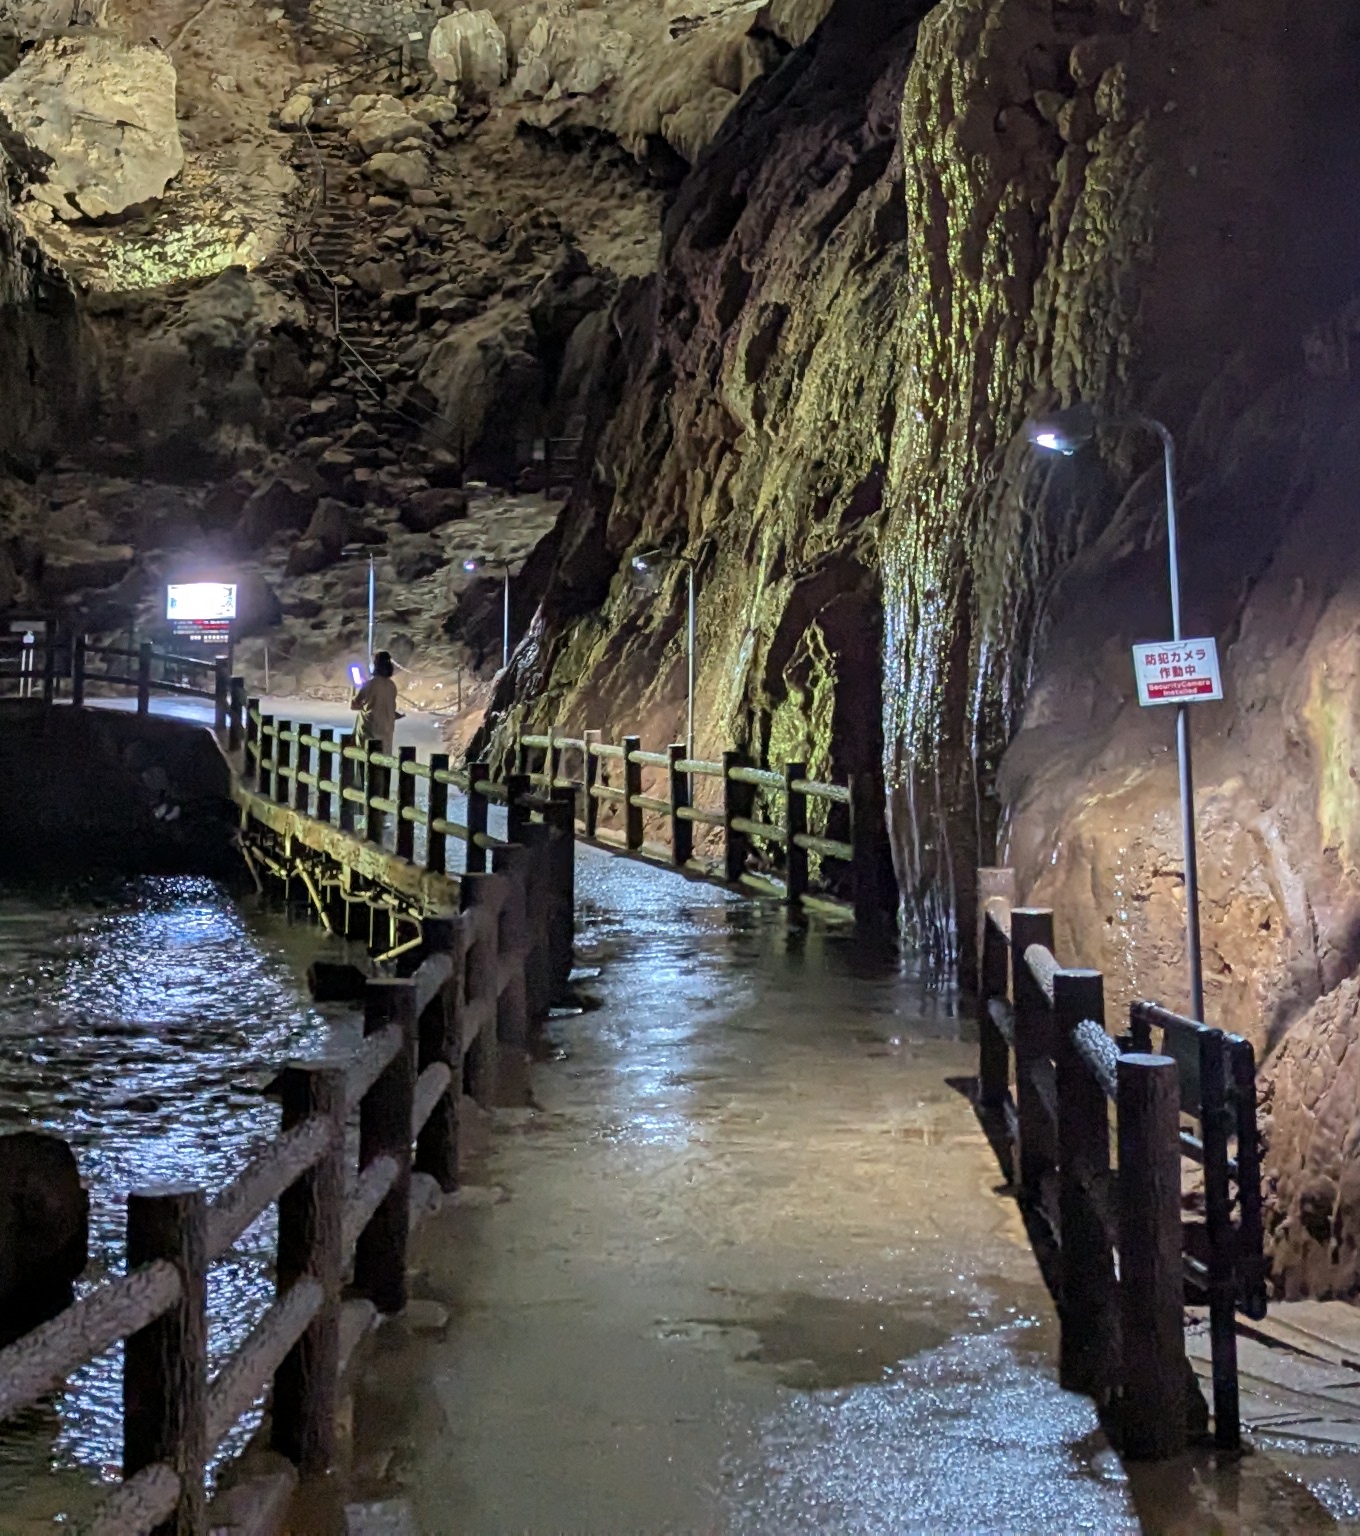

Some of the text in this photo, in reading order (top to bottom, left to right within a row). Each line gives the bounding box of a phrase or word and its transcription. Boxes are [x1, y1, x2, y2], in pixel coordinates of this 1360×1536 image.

[1144, 648, 1207, 666] 防犯カメラ
[1158, 664, 1197, 679] 作動中
